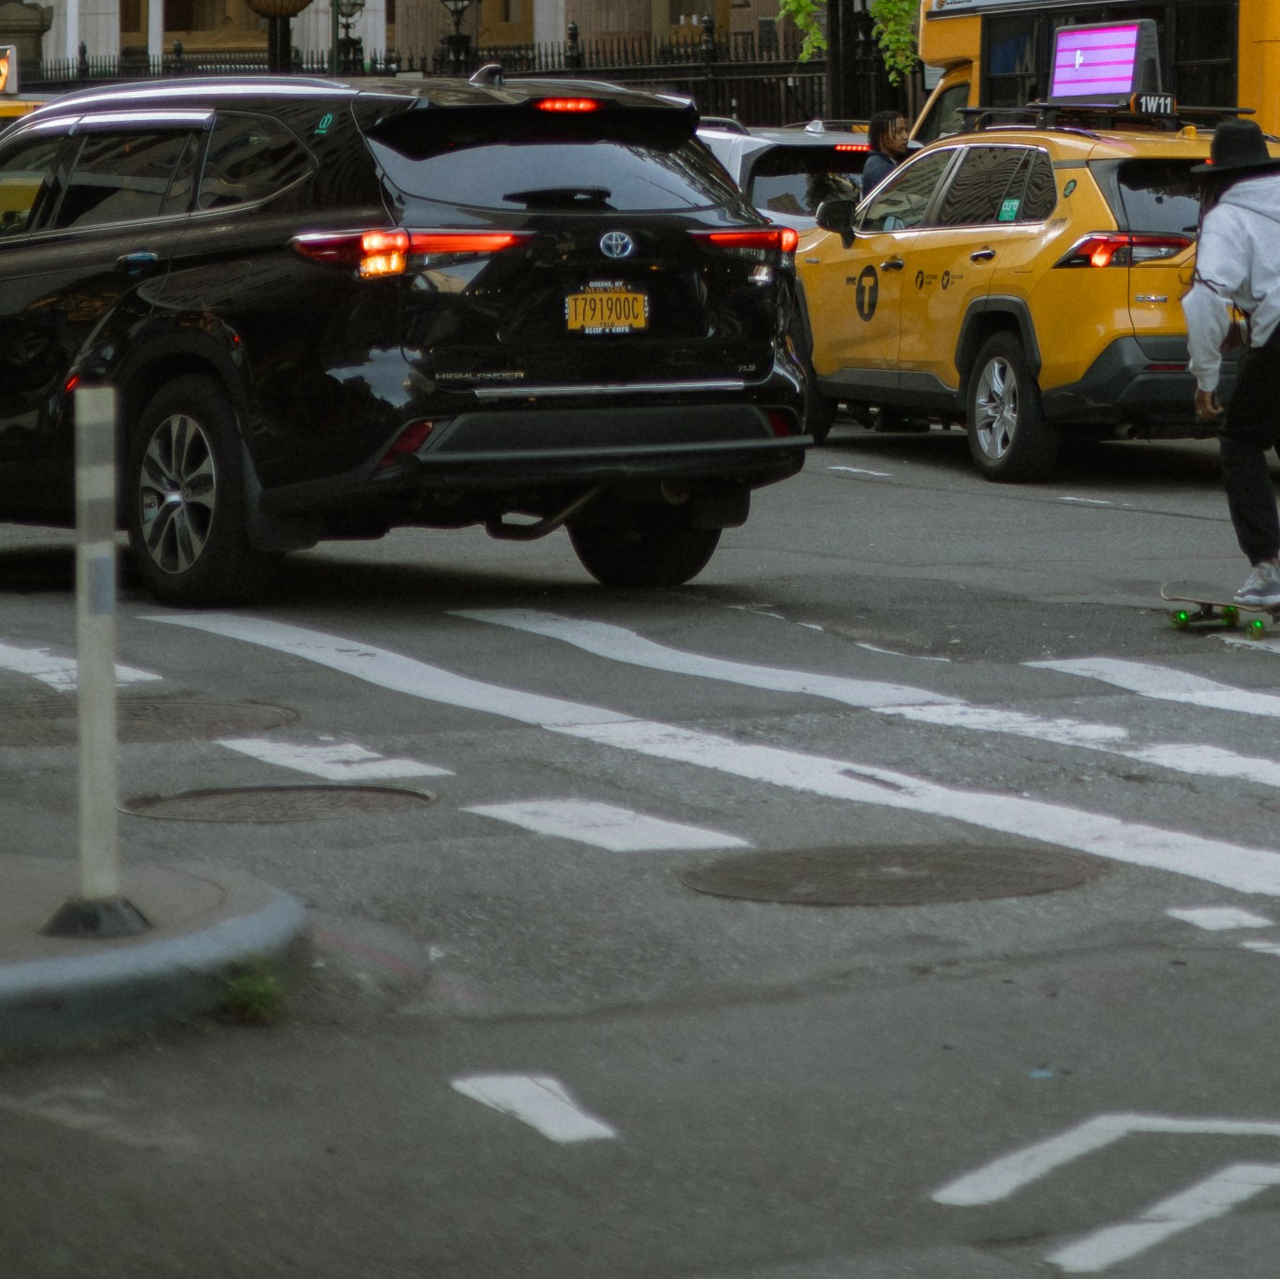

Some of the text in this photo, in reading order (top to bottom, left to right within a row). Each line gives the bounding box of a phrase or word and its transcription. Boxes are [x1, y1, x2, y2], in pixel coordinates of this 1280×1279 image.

[1140, 96, 1172, 114] 1W11
[572, 297, 639, 322] T791900C
[435, 372, 524, 380] HIGHLANDER
